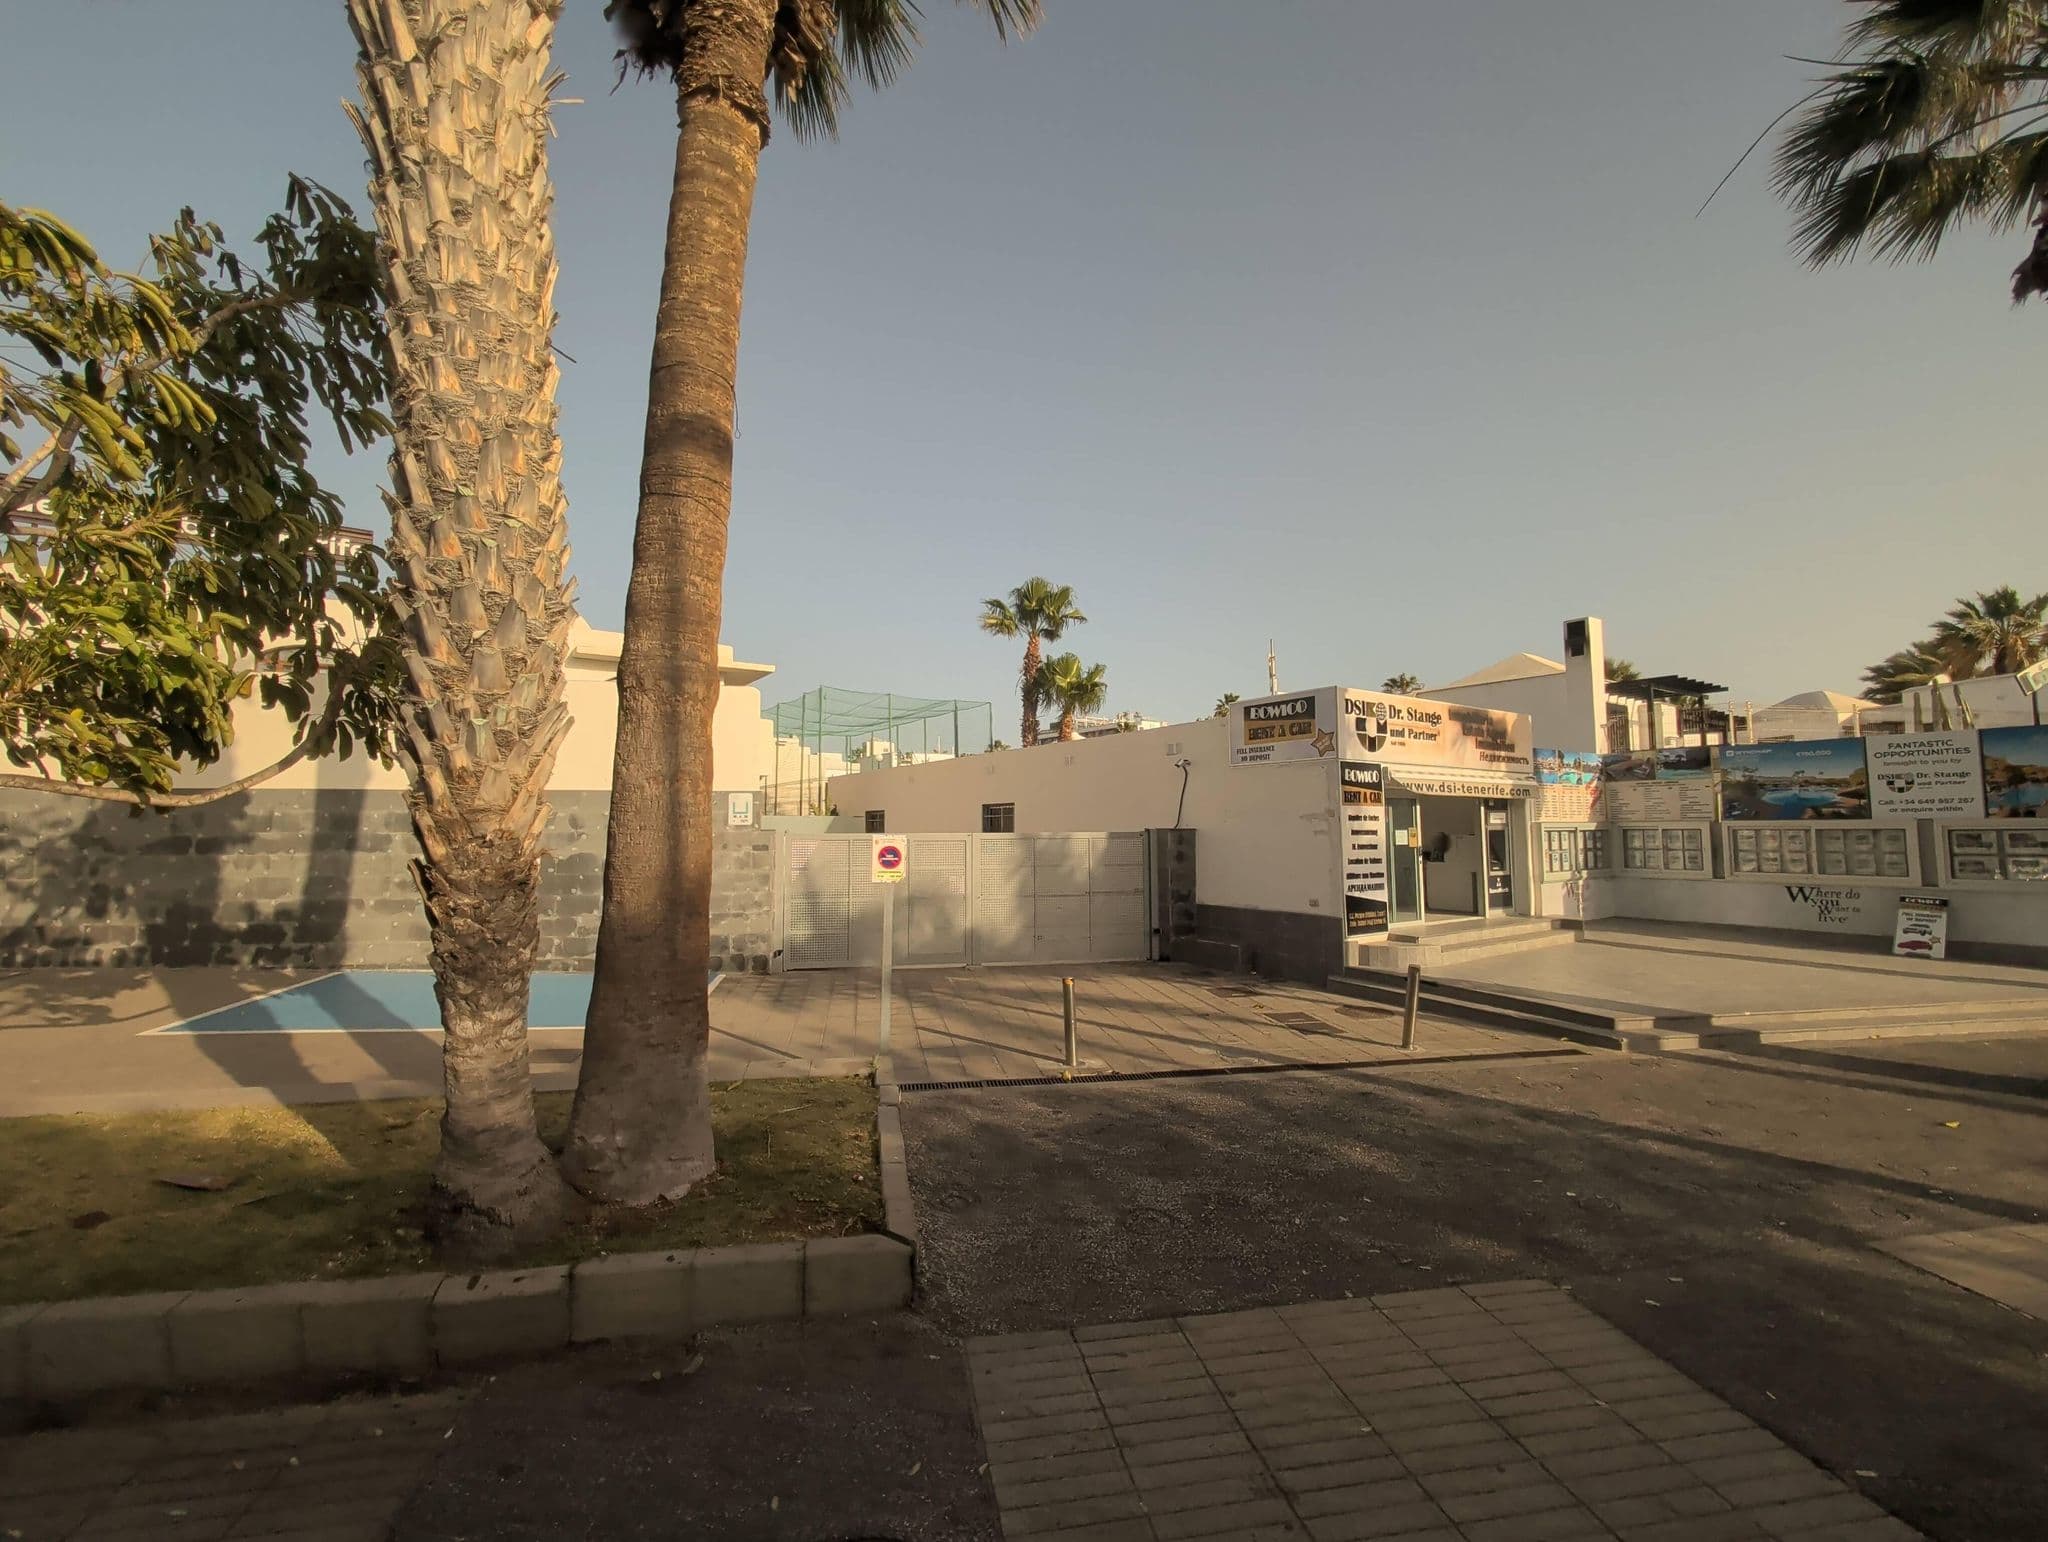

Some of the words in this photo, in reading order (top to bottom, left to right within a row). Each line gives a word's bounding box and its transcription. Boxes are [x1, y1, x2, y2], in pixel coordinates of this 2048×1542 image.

[1344, 699, 1365, 716] DSI
[1388, 704, 1404, 720] Dr.
[1407, 707, 1442, 727] Stange
[1389, 728, 1405, 738] und
[1407, 728, 1438, 742] Partner
[1887, 739, 1954, 750] FANTASTIC
[1874, 747, 1972, 759] OPPORTUNITIES
[1784, 886, 1842, 903] Where
[1845, 888, 1861, 899] do
[1810, 898, 1839, 907] you
[1818, 913, 1848, 923] live
